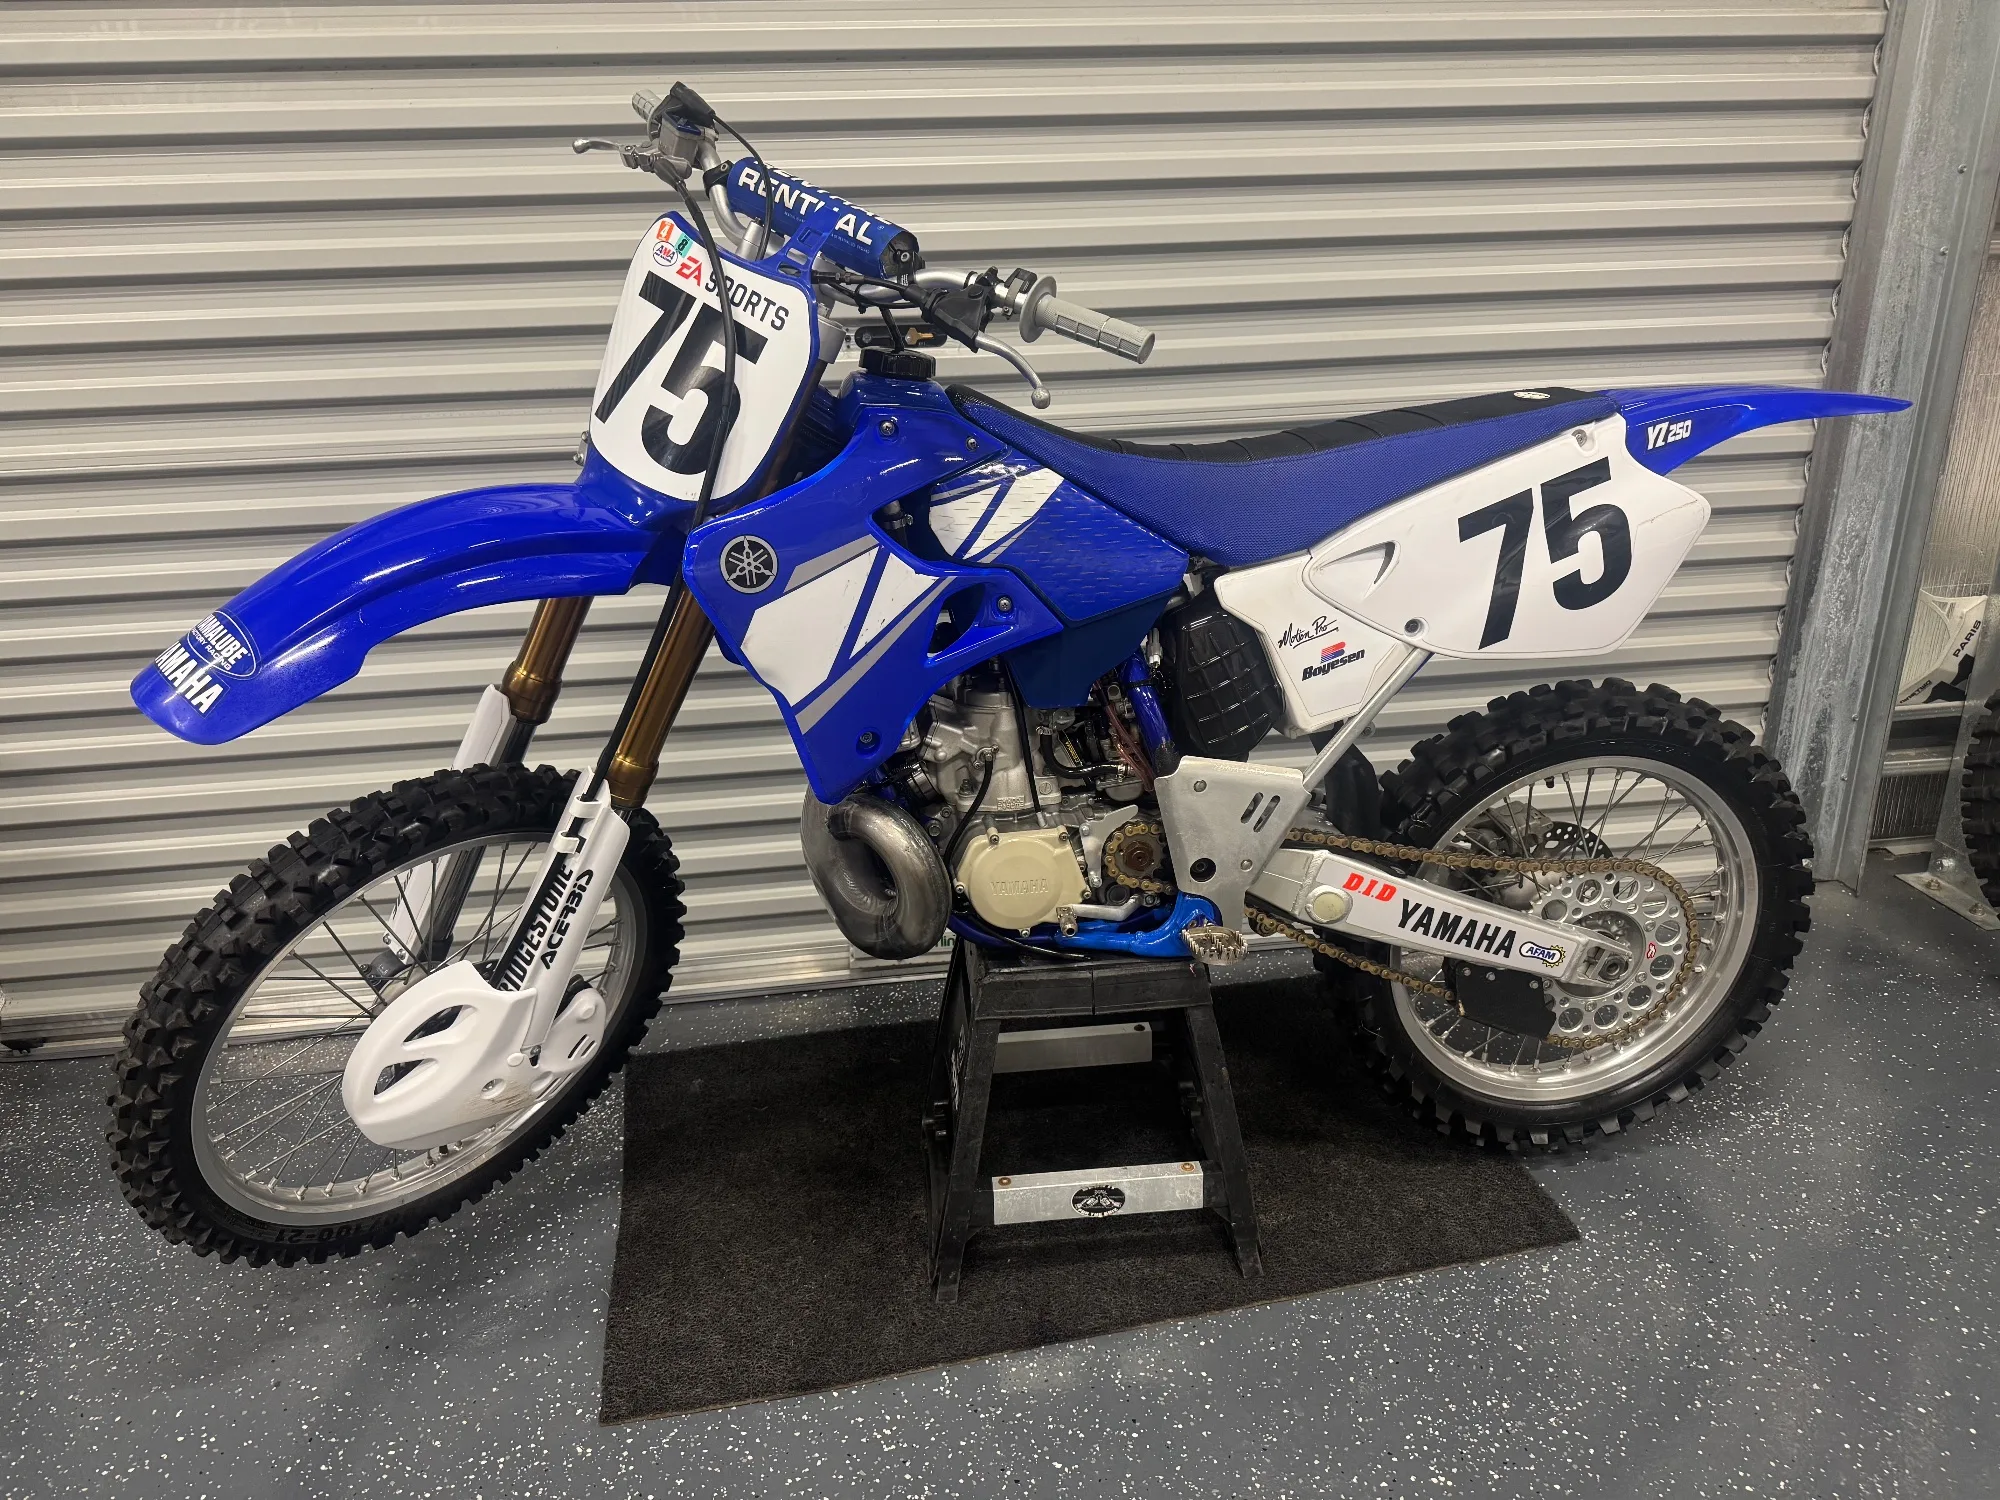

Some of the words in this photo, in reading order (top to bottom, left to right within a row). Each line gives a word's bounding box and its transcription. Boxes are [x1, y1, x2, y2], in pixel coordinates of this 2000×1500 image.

[738, 166, 873, 246] RENTAL
[656, 245, 676, 261] AMA
[676, 256, 702, 287] EA
[595, 270, 768, 475] 75
[1458, 456, 1632, 650] 75
[197, 614, 248, 665] AMALUBE
[1278, 623, 1314, 649] Motion
[1312, 615, 1337, 635] Pro
[1953, 620, 1981, 657] PARIS
[155, 641, 223, 714] AMAHA
[1302, 649, 1365, 681] Boyesen
[990, 878, 1050, 897] YAMAHA
[1398, 898, 1516, 958] YAMAHA
[1526, 945, 1556, 961] AFAM
